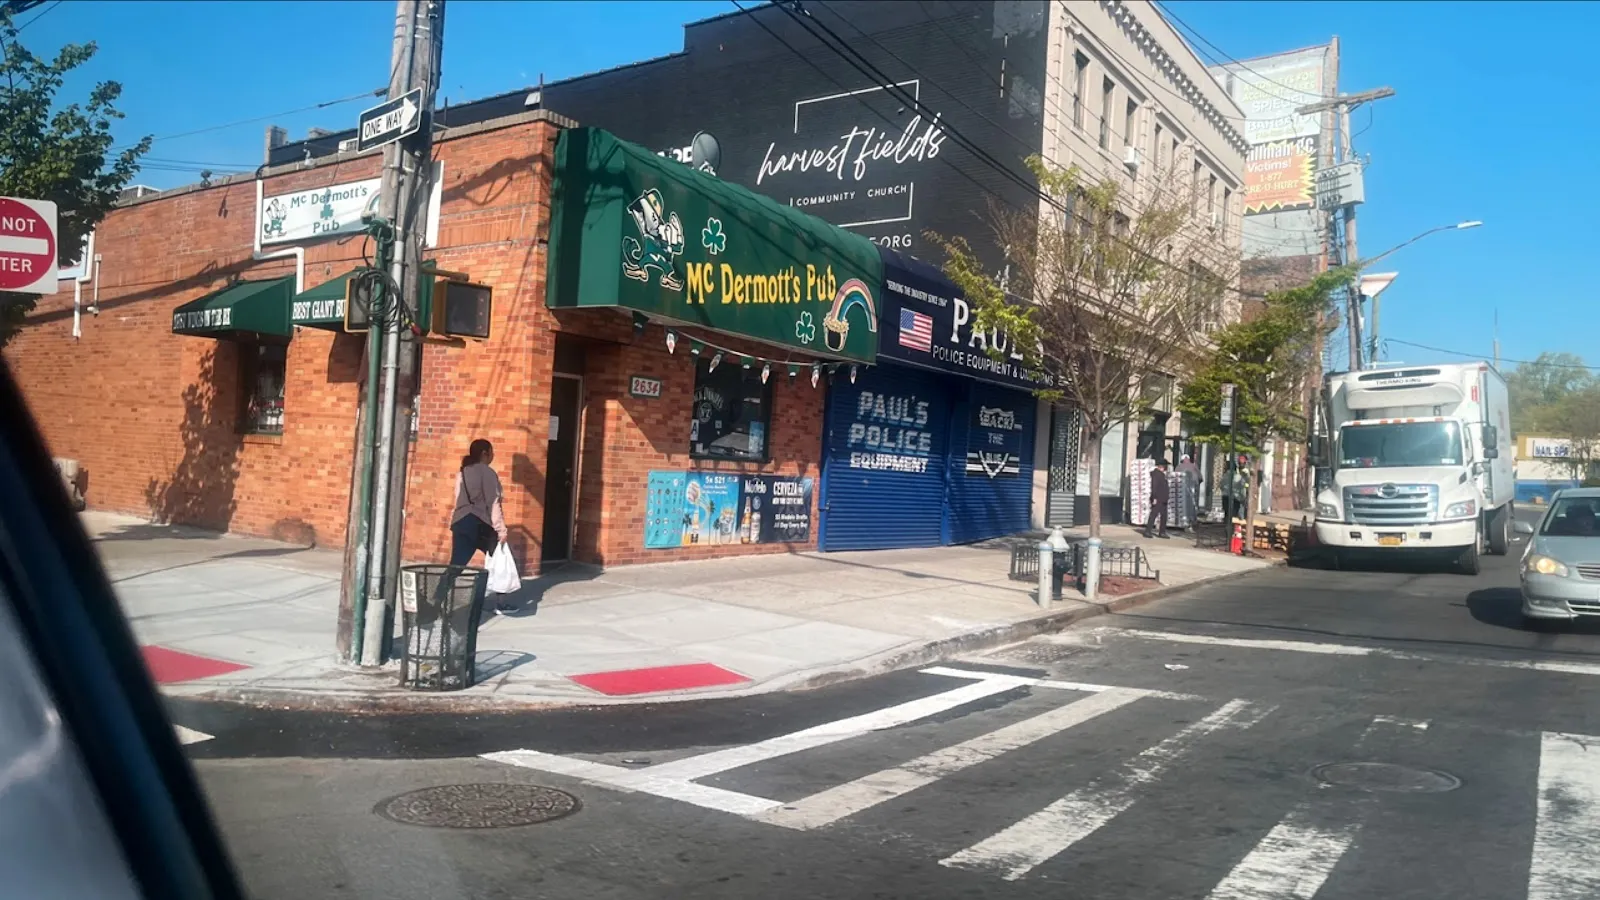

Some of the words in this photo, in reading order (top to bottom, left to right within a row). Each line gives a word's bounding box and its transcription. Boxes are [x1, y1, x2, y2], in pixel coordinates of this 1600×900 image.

[364, 121, 381, 138] ONE
[386, 110, 404, 128] WAY
[757, 125, 866, 185] harvest
[1248, 159, 1292, 173] Victims!
[1260, 172, 1283, 183] 1-877
[311, 185, 368, 205] Dermott's
[796, 191, 856, 206] COMMUNITY
[867, 184, 907, 198] CHURCH
[2, 216, 36, 233] NOT
[313, 220, 340, 234] Pub
[0, 256, 32, 273] TER
[720, 263, 801, 304] Dermott's
[806, 264, 837, 302] Pub
[292, 302, 310, 319] BEST
[312, 300, 334, 318] GIANT
[933, 345, 965, 367] POLICE
[966, 355, 1011, 377] EQUIPMENT
[1012, 365, 1018, 378] &
[633, 380, 659, 394] 2634
[859, 391, 930, 425] PAUL'S
[850, 423, 932, 454] POLICE
[850, 452, 929, 473] EQUIPMENT
[744, 479, 767, 494] Modelo
[773, 482, 798, 497] CERVEZA
